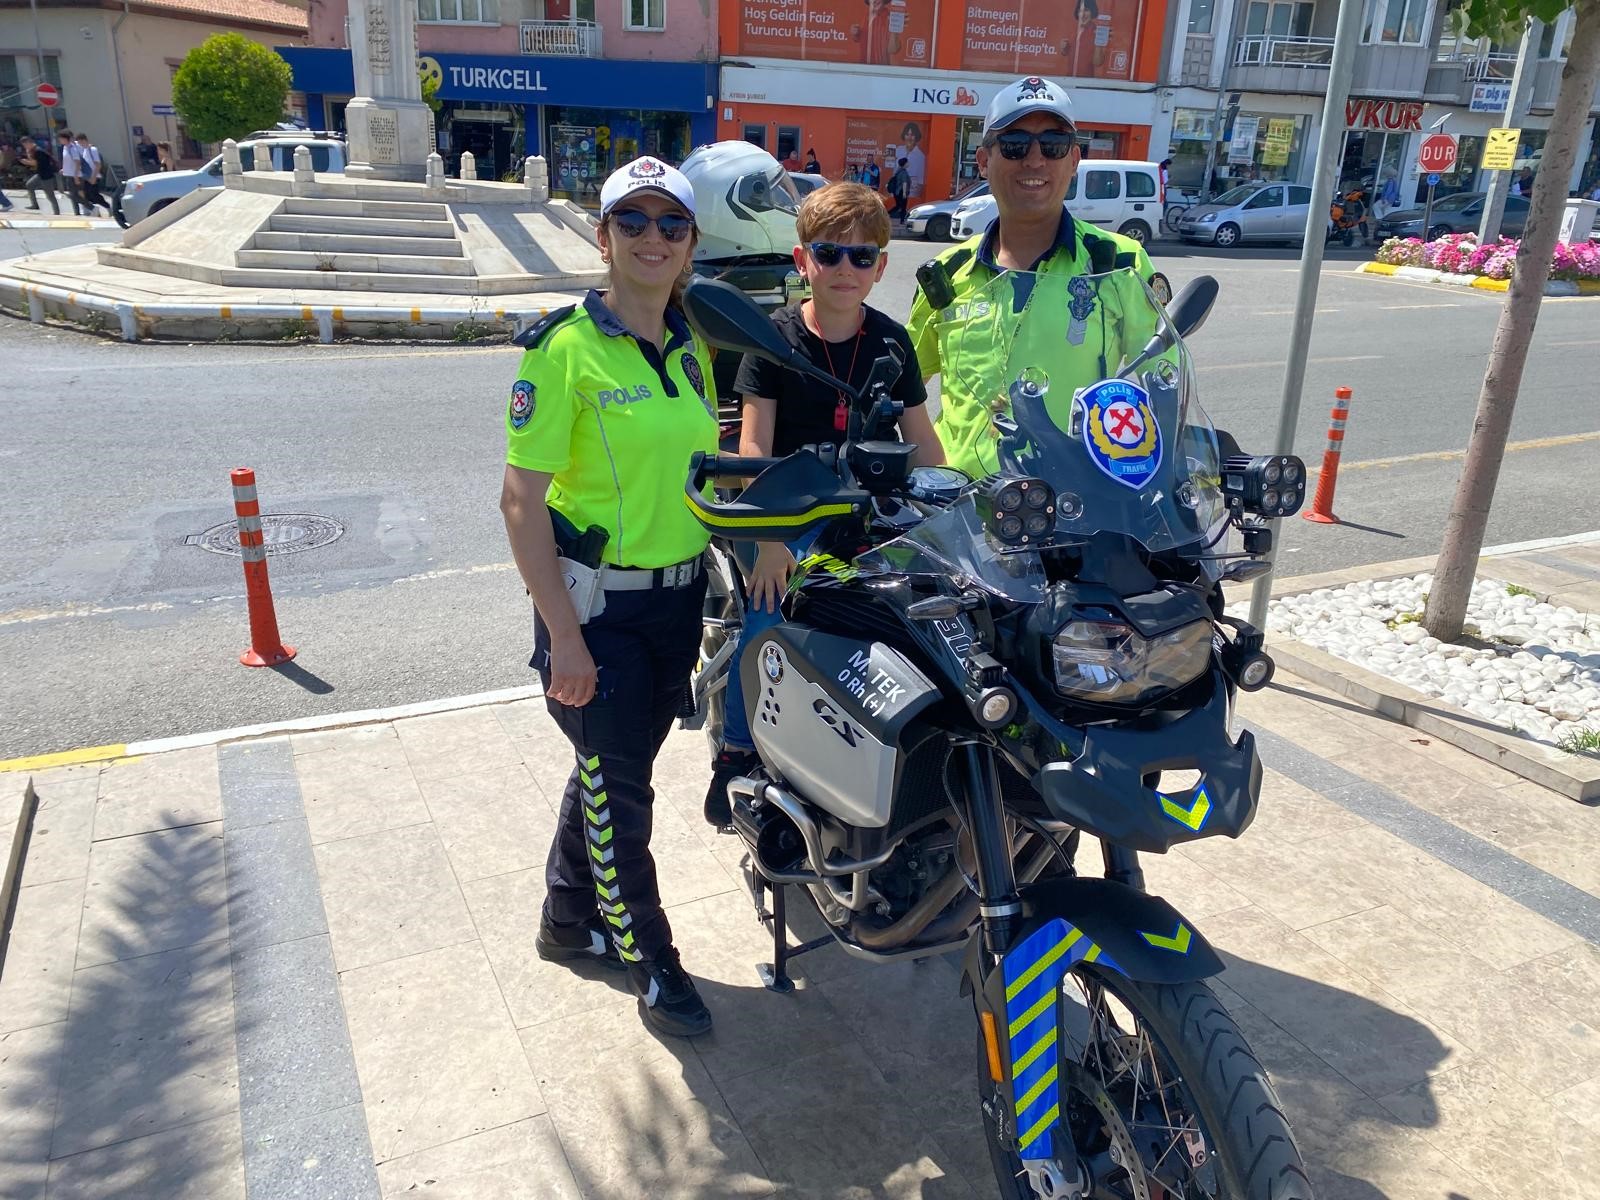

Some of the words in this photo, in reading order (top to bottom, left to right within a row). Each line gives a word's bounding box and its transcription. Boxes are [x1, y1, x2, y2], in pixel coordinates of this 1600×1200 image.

[745, 7, 767, 22] Hoş
[770, 9, 806, 22] Geldin
[809, 11, 835, 24] Faizi
[967, 6, 1018, 23] Bitmeyen
[745, 23, 792, 37] Turuncu
[795, 26, 848, 42] Hesap'ta.
[966, 23, 986, 37] Hoş
[988, 24, 1022, 37] Geldin
[1024, 27, 1048, 38] Faizi
[965, 38, 1007, 51] Turuncu
[1009, 41, 1057, 56] Hesap'ta.
[449, 66, 548, 91] TURKCELL
[912, 88, 951, 105] ING
[1345, 99, 1424, 131] VKUR
[1422, 146, 1455, 161] DUR
[597, 384, 653, 409] POLİS
[1101, 385, 1132, 397] POLİS
[933, 616, 974, 671] 90
[848, 649, 872, 677] M.
[870, 667, 906, 704] TEK
[846, 676, 866, 699] Rh
[862, 692, 886, 718] (+)
[812, 698, 865, 748] GS
